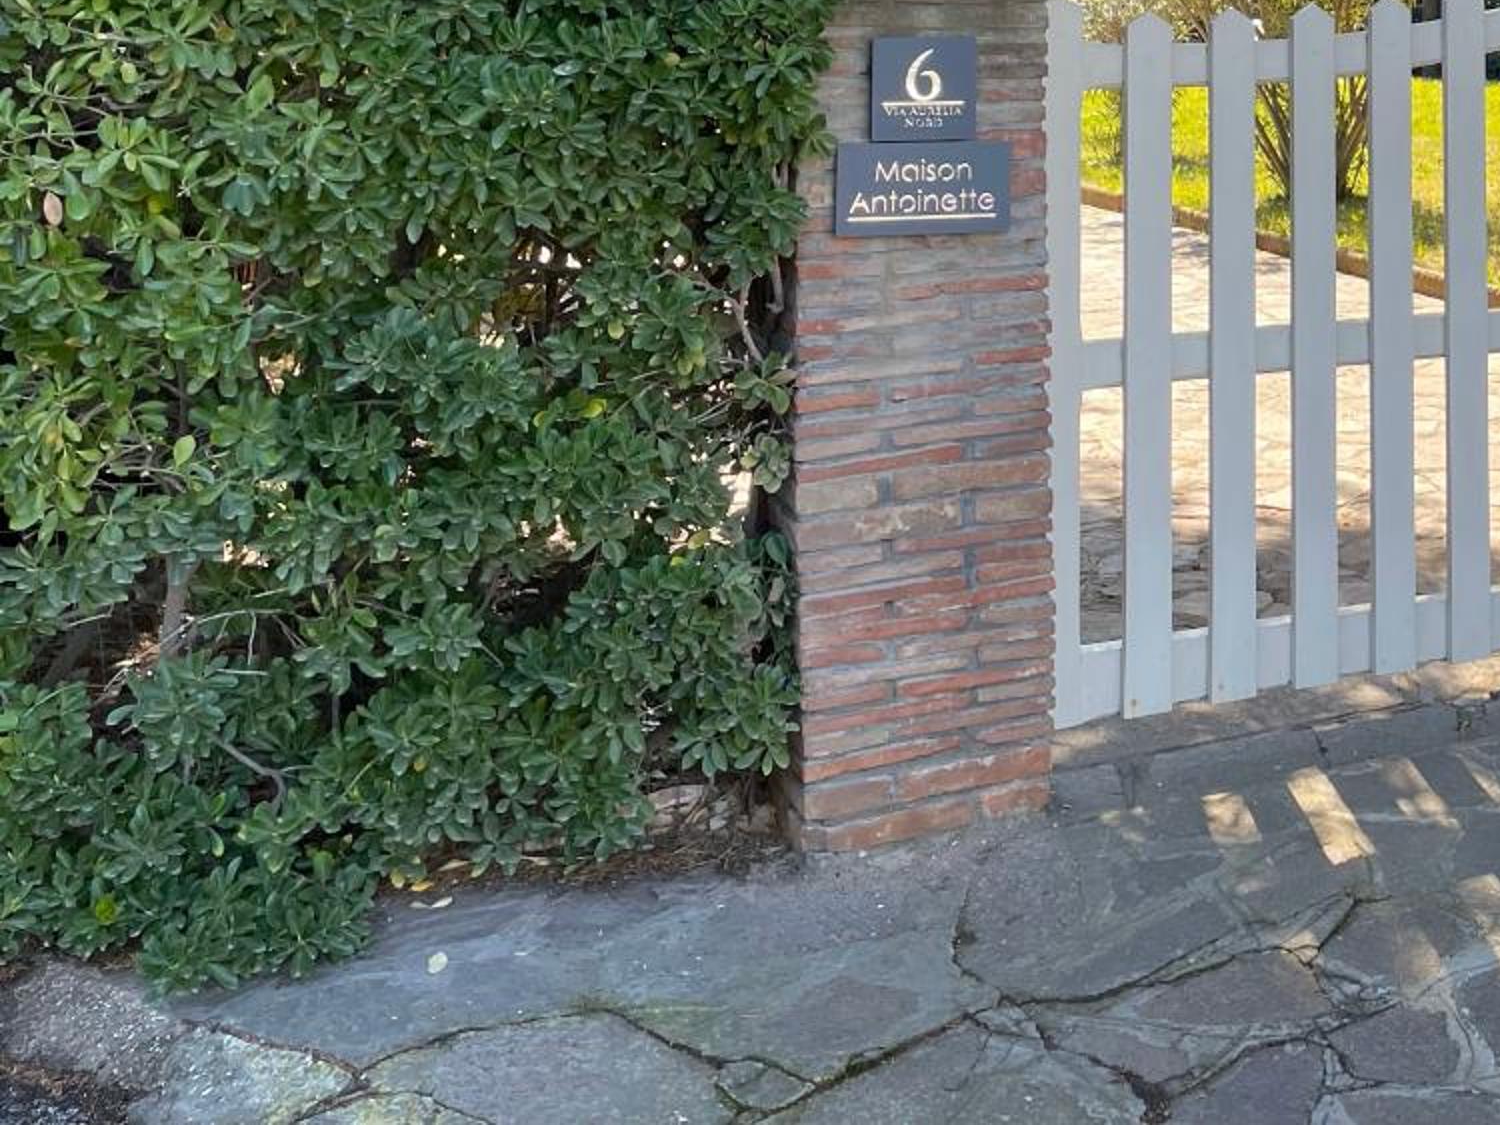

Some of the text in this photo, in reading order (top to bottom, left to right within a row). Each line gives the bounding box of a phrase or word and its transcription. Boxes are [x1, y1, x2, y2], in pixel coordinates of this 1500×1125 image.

[904, 48, 942, 101] 6
[874, 158, 973, 183] Maison
[849, 188, 996, 215] Antoinette
